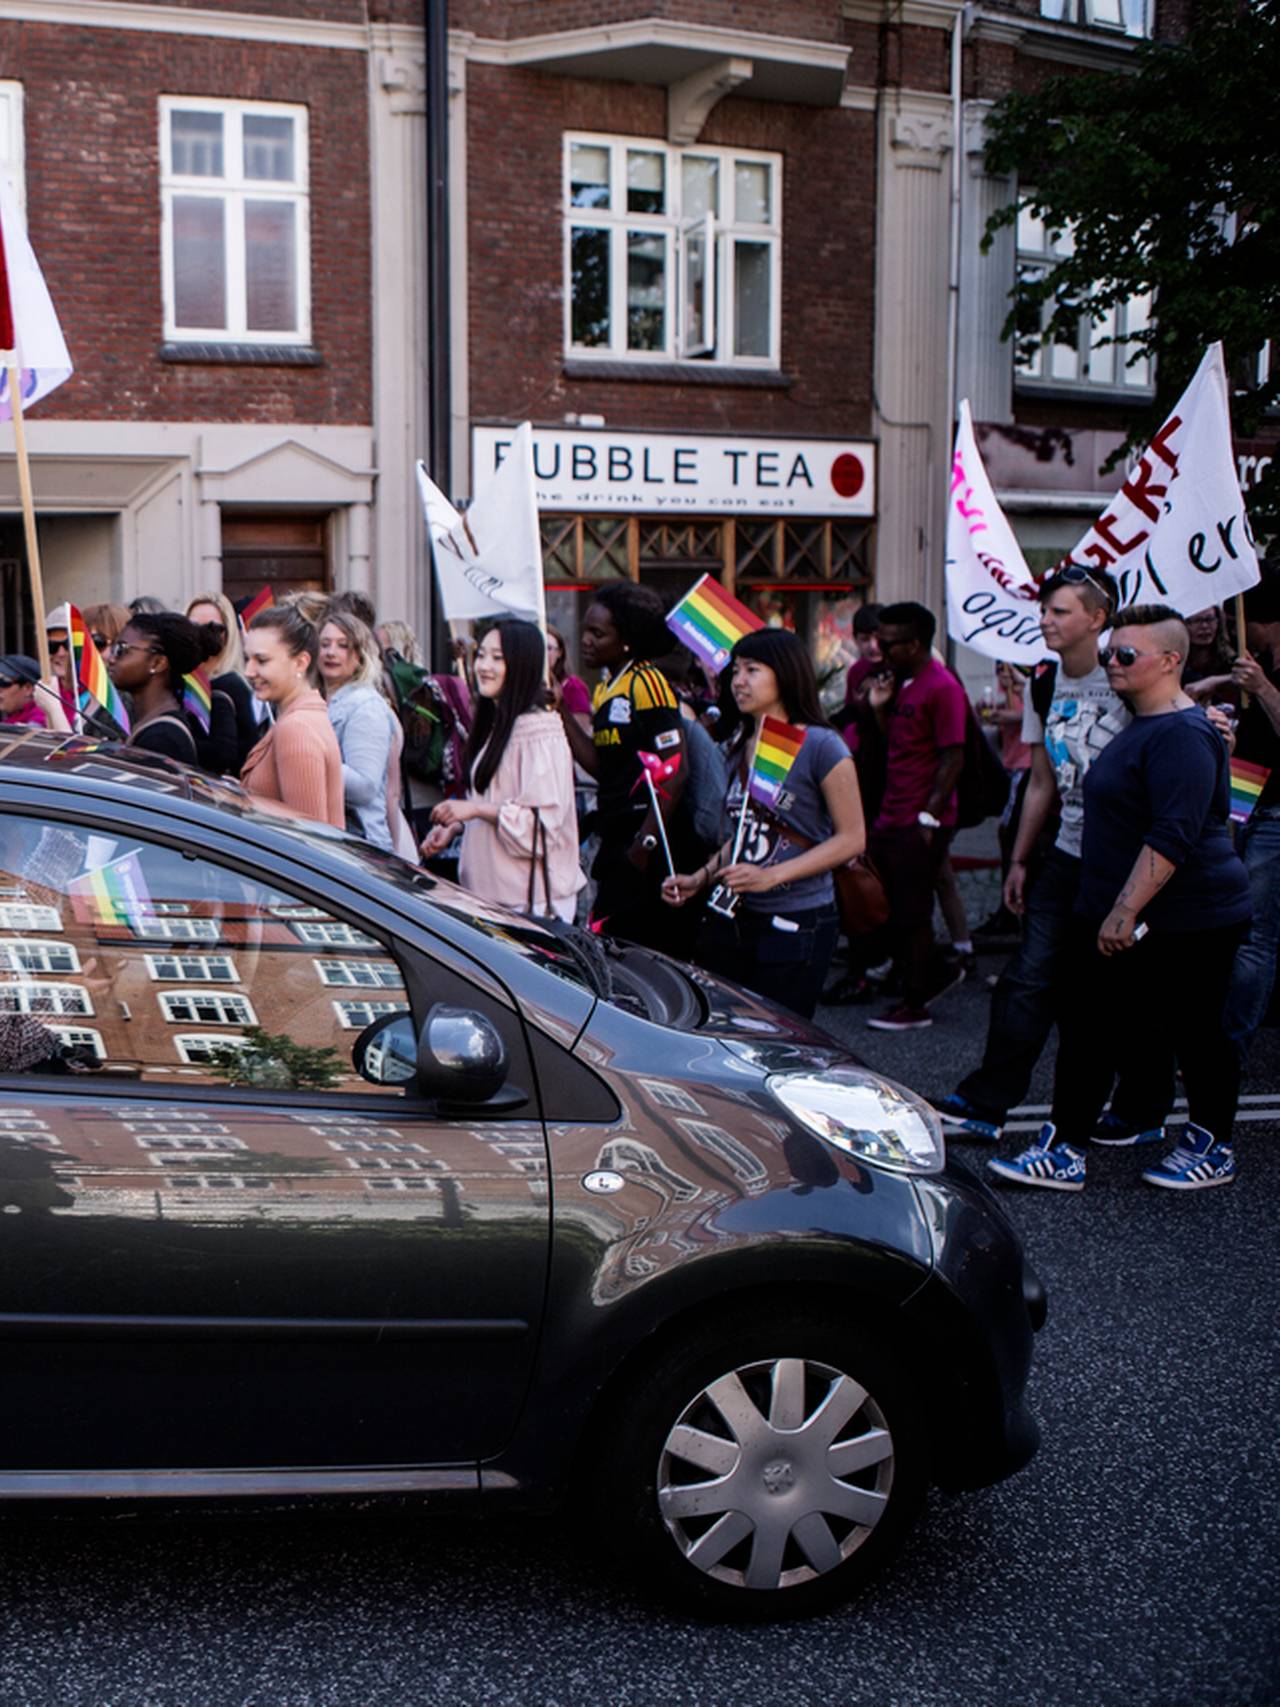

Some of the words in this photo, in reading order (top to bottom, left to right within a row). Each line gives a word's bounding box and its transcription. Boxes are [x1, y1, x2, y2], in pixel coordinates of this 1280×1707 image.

[723, 450, 814, 488] TEA
[577, 492, 644, 503] drink
[656, 496, 697, 506] you
[708, 498, 748, 506] can
[758, 498, 795, 507] eat
